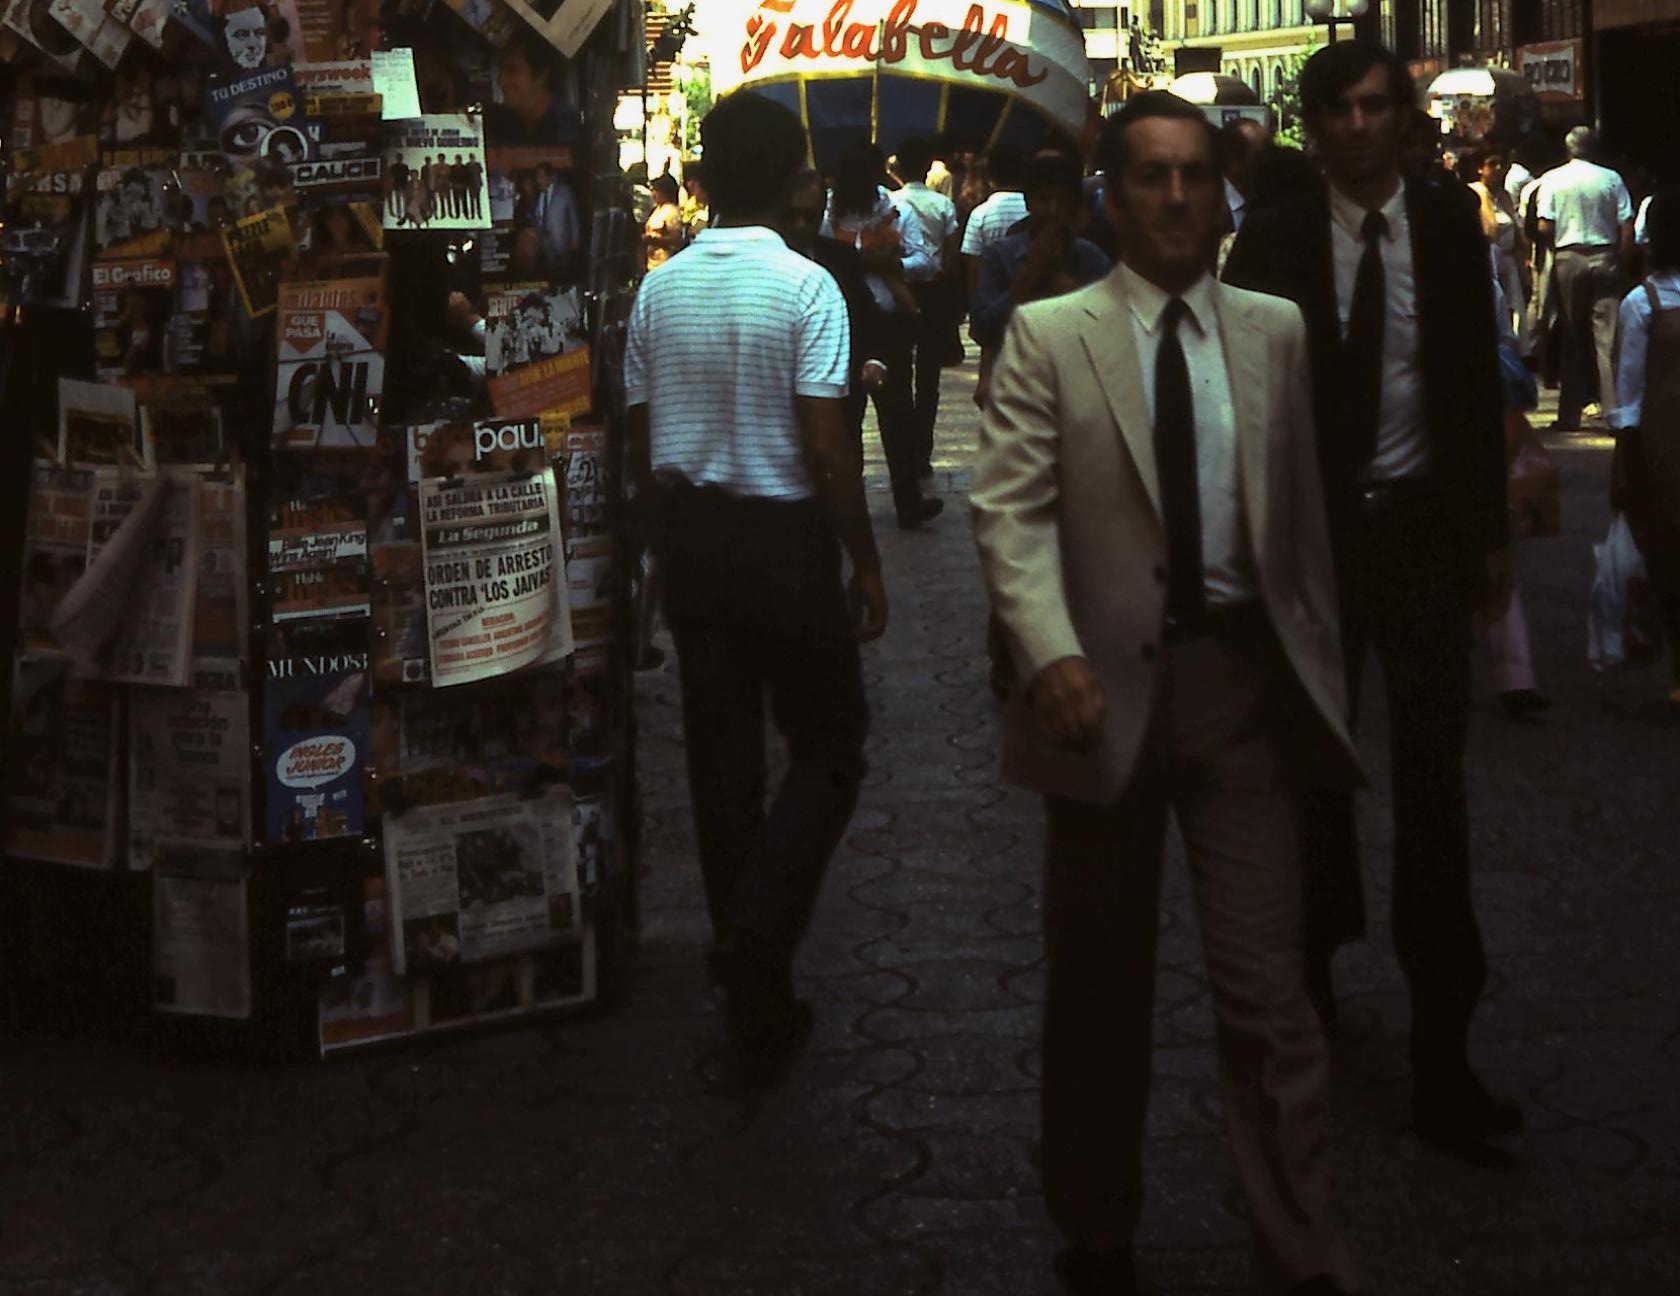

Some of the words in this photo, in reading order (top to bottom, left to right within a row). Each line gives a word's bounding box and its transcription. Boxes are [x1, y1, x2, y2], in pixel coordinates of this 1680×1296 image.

[229, 68, 288, 96] DESTINO
[93, 267, 109, 284] El
[291, 315, 320, 326] QUE
[286, 326, 321, 337] PASA
[473, 421, 544, 461] pau
[496, 487, 508, 499] LA
[511, 482, 541, 497] CALLE
[487, 496, 545, 515] TRIBUTARIA
[439, 531, 460, 543] La
[463, 521, 539, 541] Segunda
[428, 561, 470, 585] ORDEN
[475, 558, 492, 579] DE
[498, 543, 554, 577] ARRESTO
[430, 584, 478, 610] CONTRA
[286, 756, 345, 775] JUNIOR
